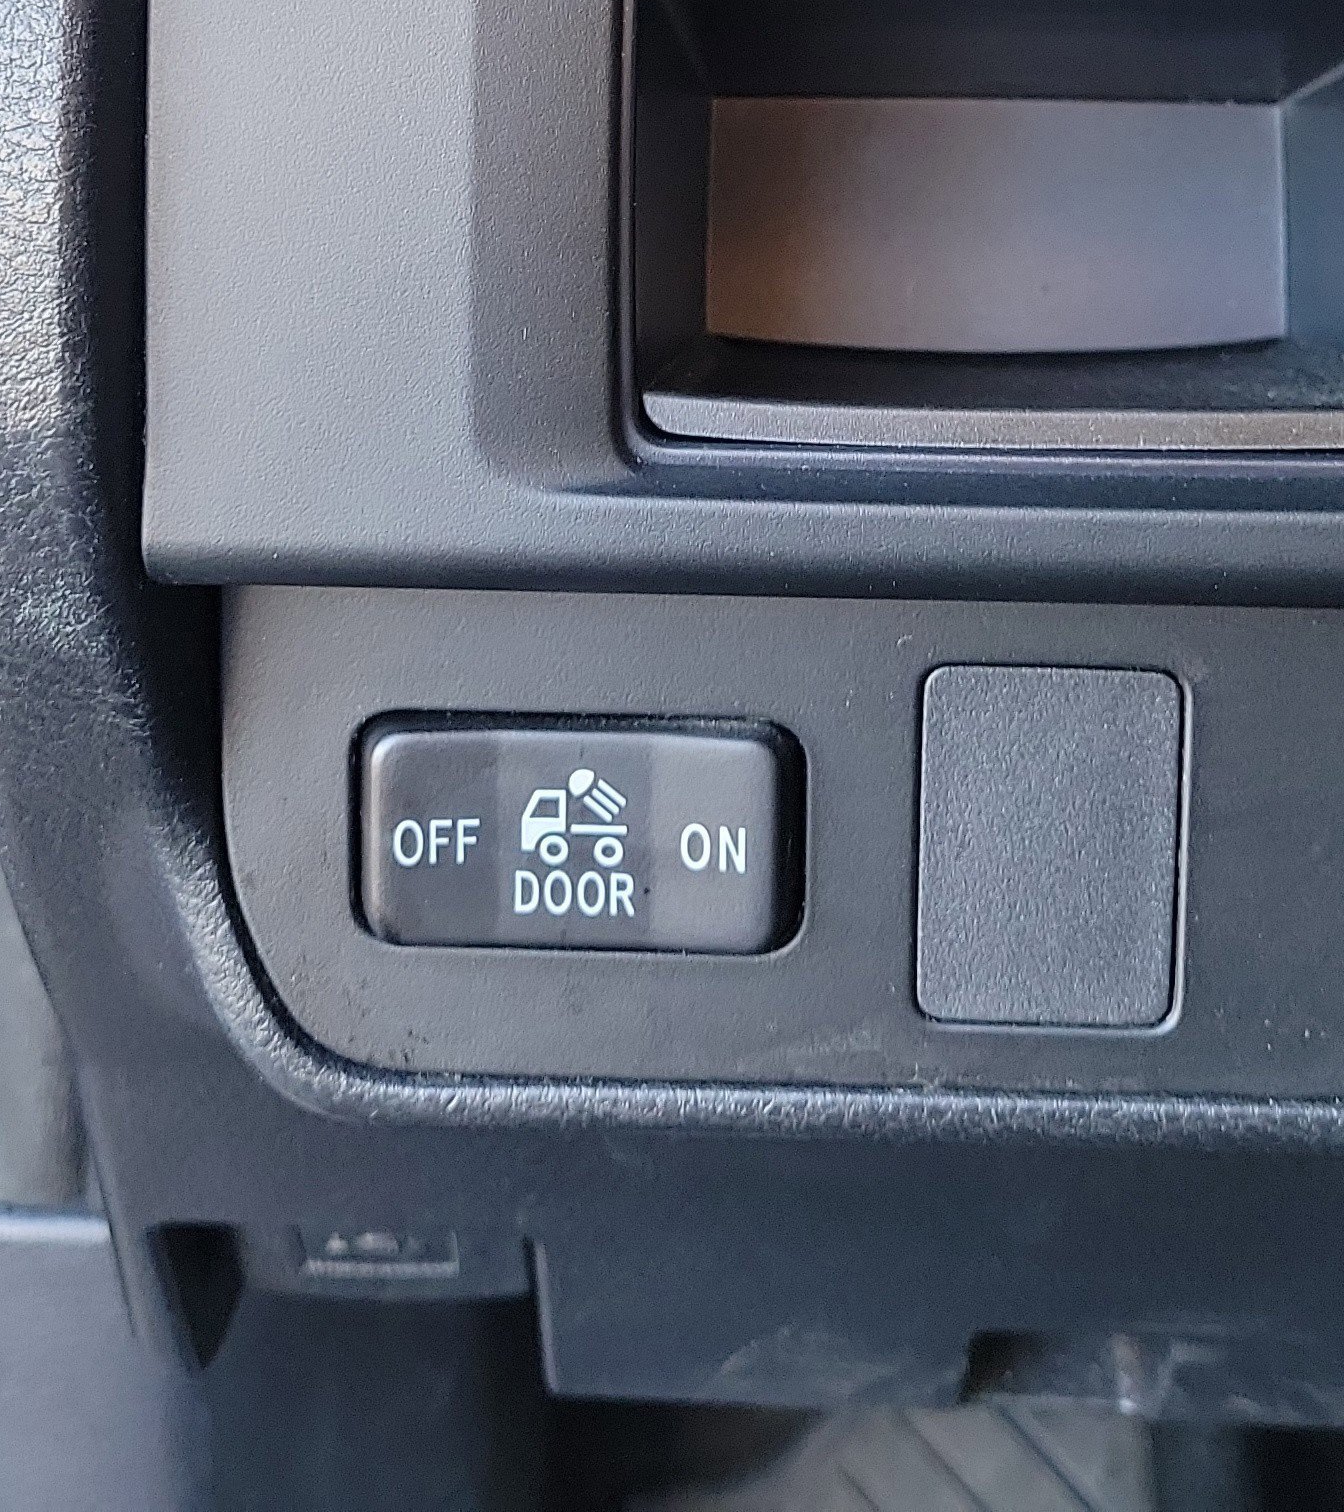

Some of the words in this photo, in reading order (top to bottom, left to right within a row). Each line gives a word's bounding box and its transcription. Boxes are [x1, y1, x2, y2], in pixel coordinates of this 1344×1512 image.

[392, 818, 482, 867] OFF
[679, 822, 747, 874] ON
[513, 869, 636, 918] DOOR
